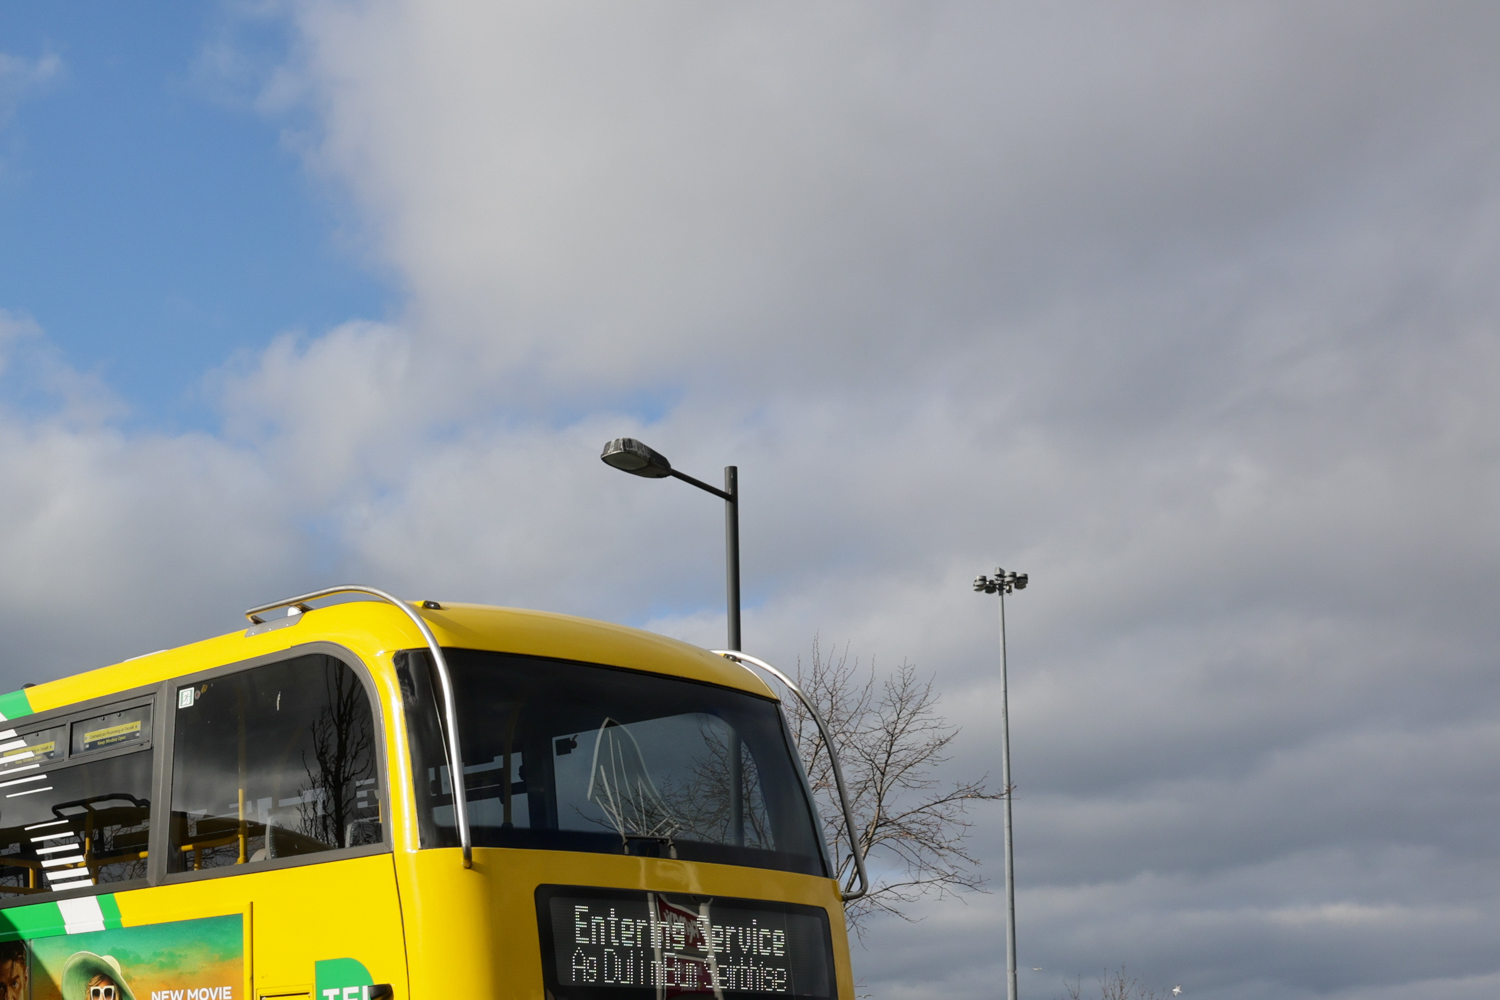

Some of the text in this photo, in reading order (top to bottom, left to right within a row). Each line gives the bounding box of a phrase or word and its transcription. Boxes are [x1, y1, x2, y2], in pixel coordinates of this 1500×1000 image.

[574, 905, 786, 957] Entering Service
[572, 947, 598, 985] Ag
[604, 948, 635, 986] Dul
